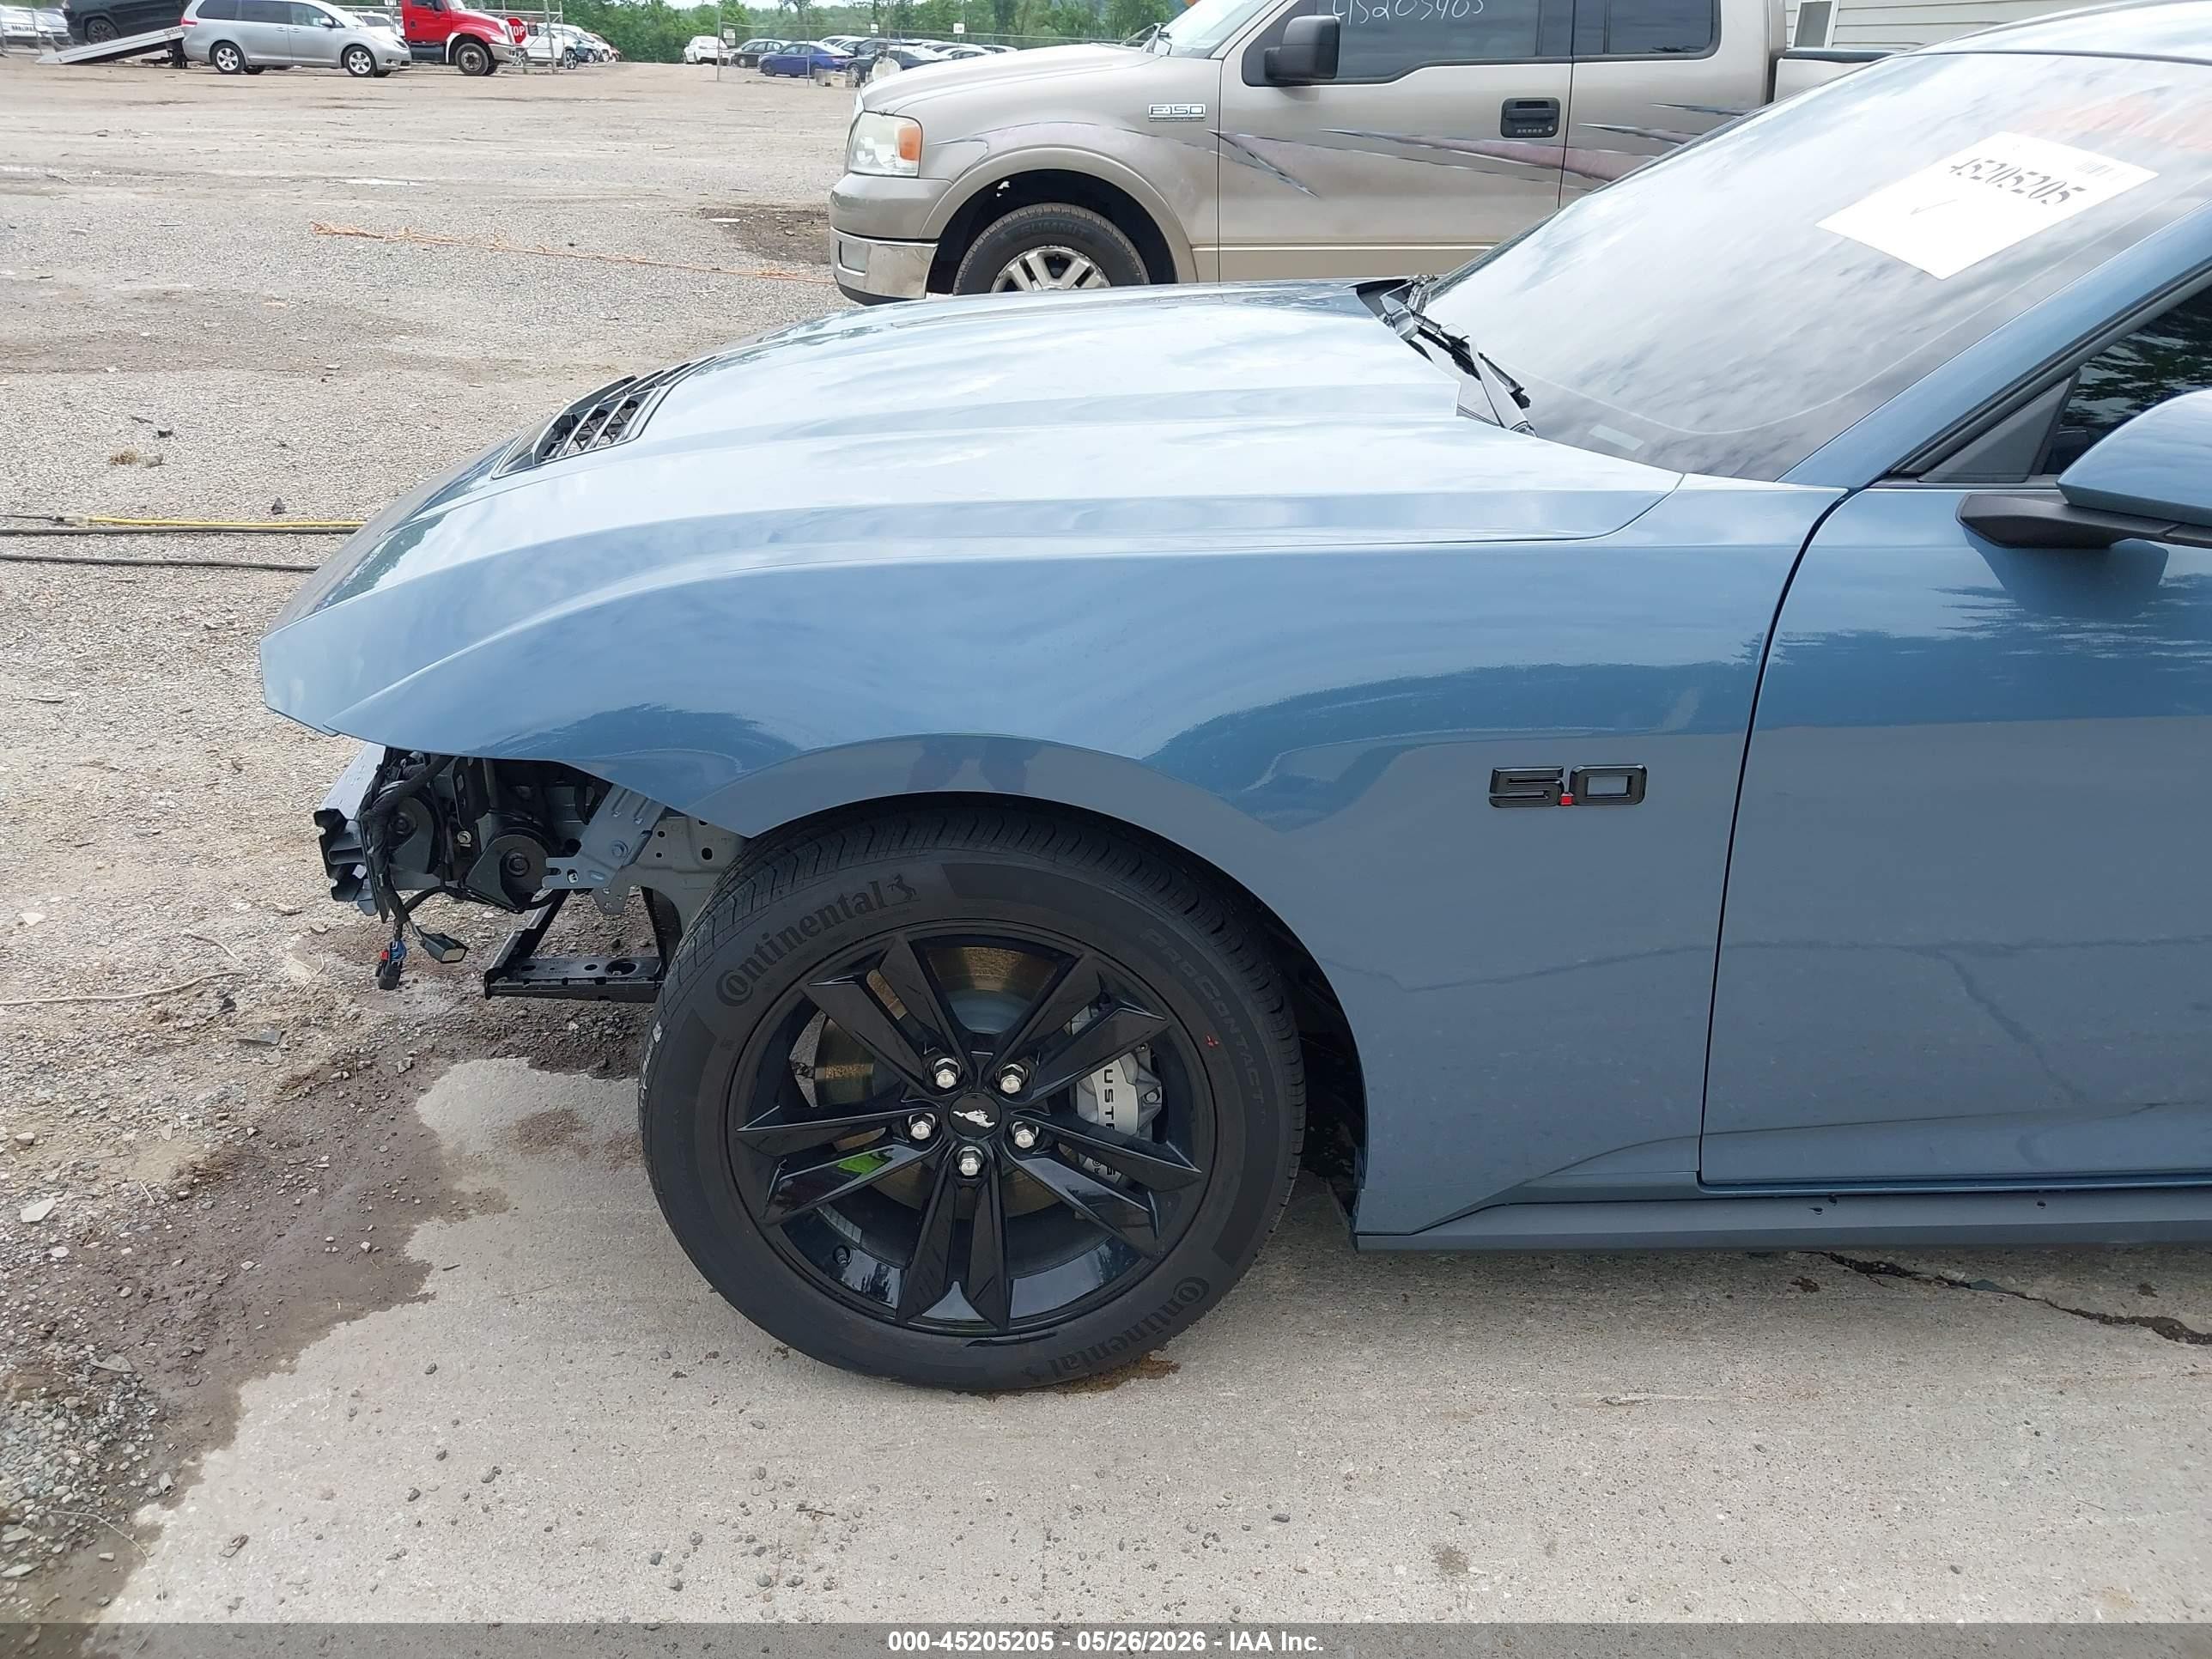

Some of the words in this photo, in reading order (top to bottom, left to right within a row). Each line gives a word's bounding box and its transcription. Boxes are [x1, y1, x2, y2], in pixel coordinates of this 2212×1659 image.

[1151, 106, 1204, 115] F-150
[1948, 157, 2087, 205] 45205205
[1488, 763, 1648, 809] 5.0
[715, 879, 889, 1007] Continental
[1047, 1276, 1210, 1379] Continental
